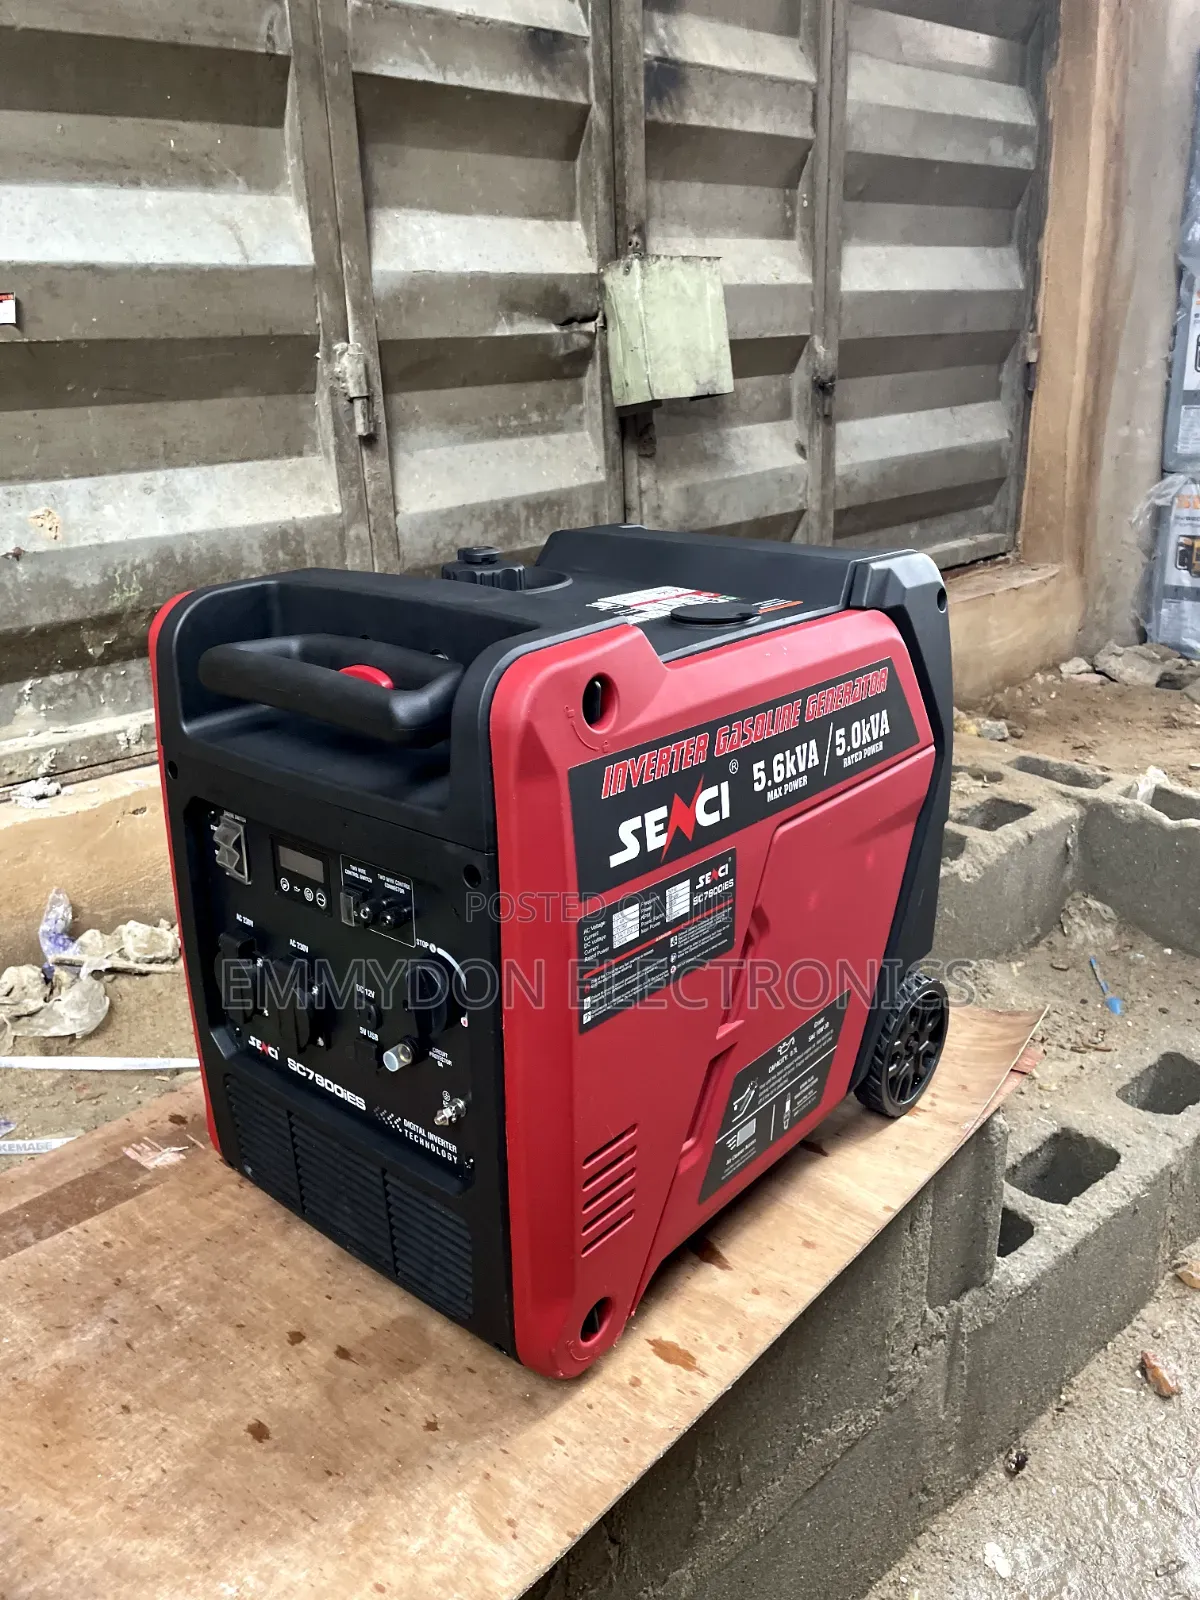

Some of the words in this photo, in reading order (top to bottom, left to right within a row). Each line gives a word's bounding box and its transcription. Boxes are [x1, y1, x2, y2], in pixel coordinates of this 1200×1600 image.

[601, 732, 709, 800] INVERTER
[714, 699, 801, 757] GASOLINE
[804, 666, 889, 722] GENERATOR
[752, 738, 820, 794] 5.6kVA
[834, 708, 891, 756] 5.0kVA
[842, 751, 863, 768] RATED
[863, 741, 884, 763] POWER
[766, 786, 783, 803] MAX
[783, 774, 808, 796] POWER
[608, 772, 731, 869] SENCI
[695, 862, 729, 890] SENCI
[416, 937, 430, 949] STOP
[364, 988, 376, 999] 12V
[248, 1035, 279, 1061] SENCI
[367, 1029, 379, 1042] USB
[287, 1056, 367, 1111] SC7800iES
[403, 1118, 426, 1138] DIGITAL
[427, 1130, 458, 1154] INVERTER
[404, 1128, 459, 1165] TECHNOLOGY
